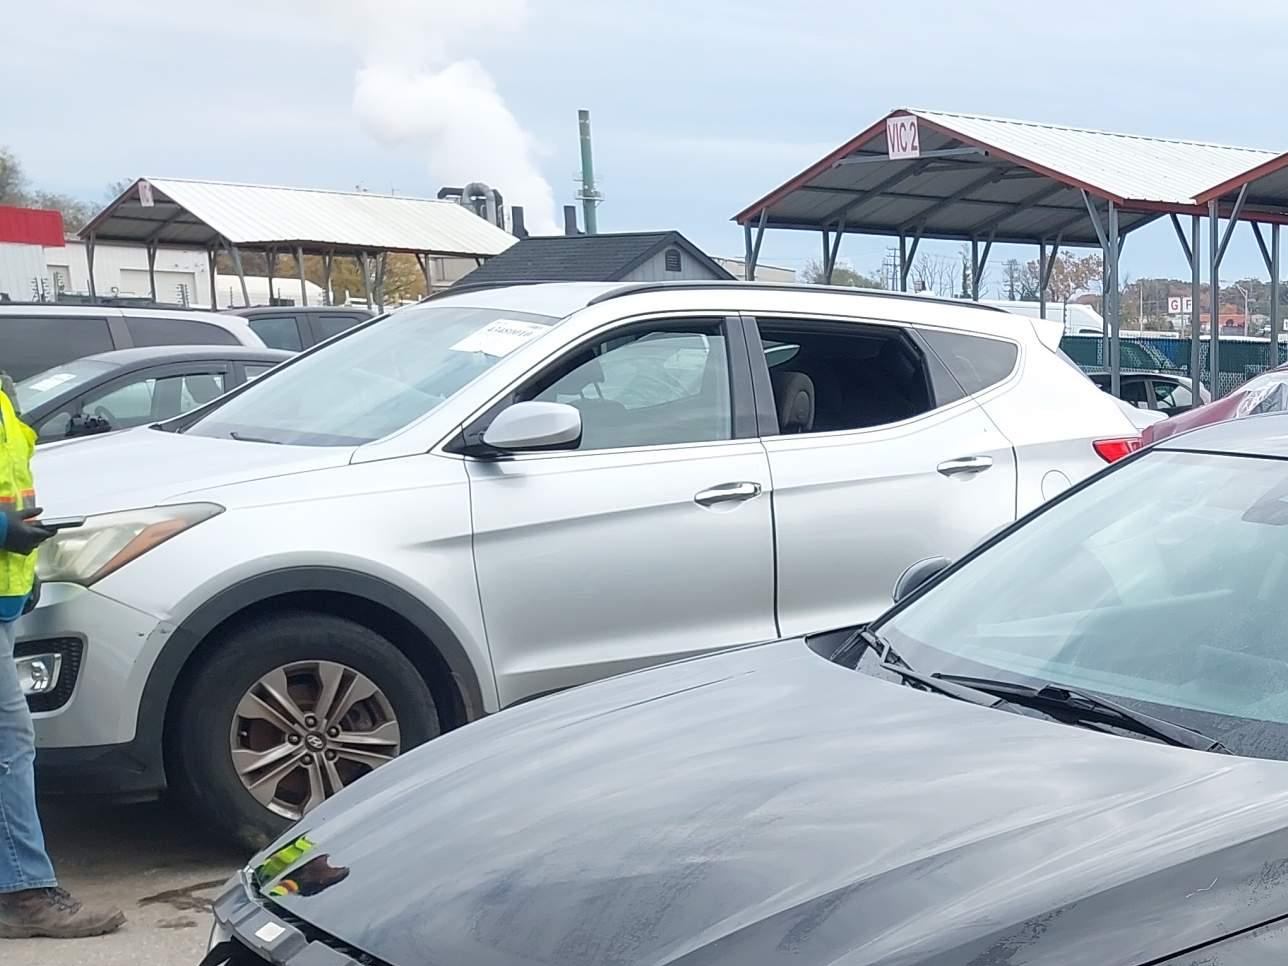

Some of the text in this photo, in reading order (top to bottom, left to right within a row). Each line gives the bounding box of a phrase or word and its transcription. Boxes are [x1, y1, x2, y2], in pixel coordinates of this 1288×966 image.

[888, 121, 918, 152] VIC 2
[1170, 300, 1179, 311] G
